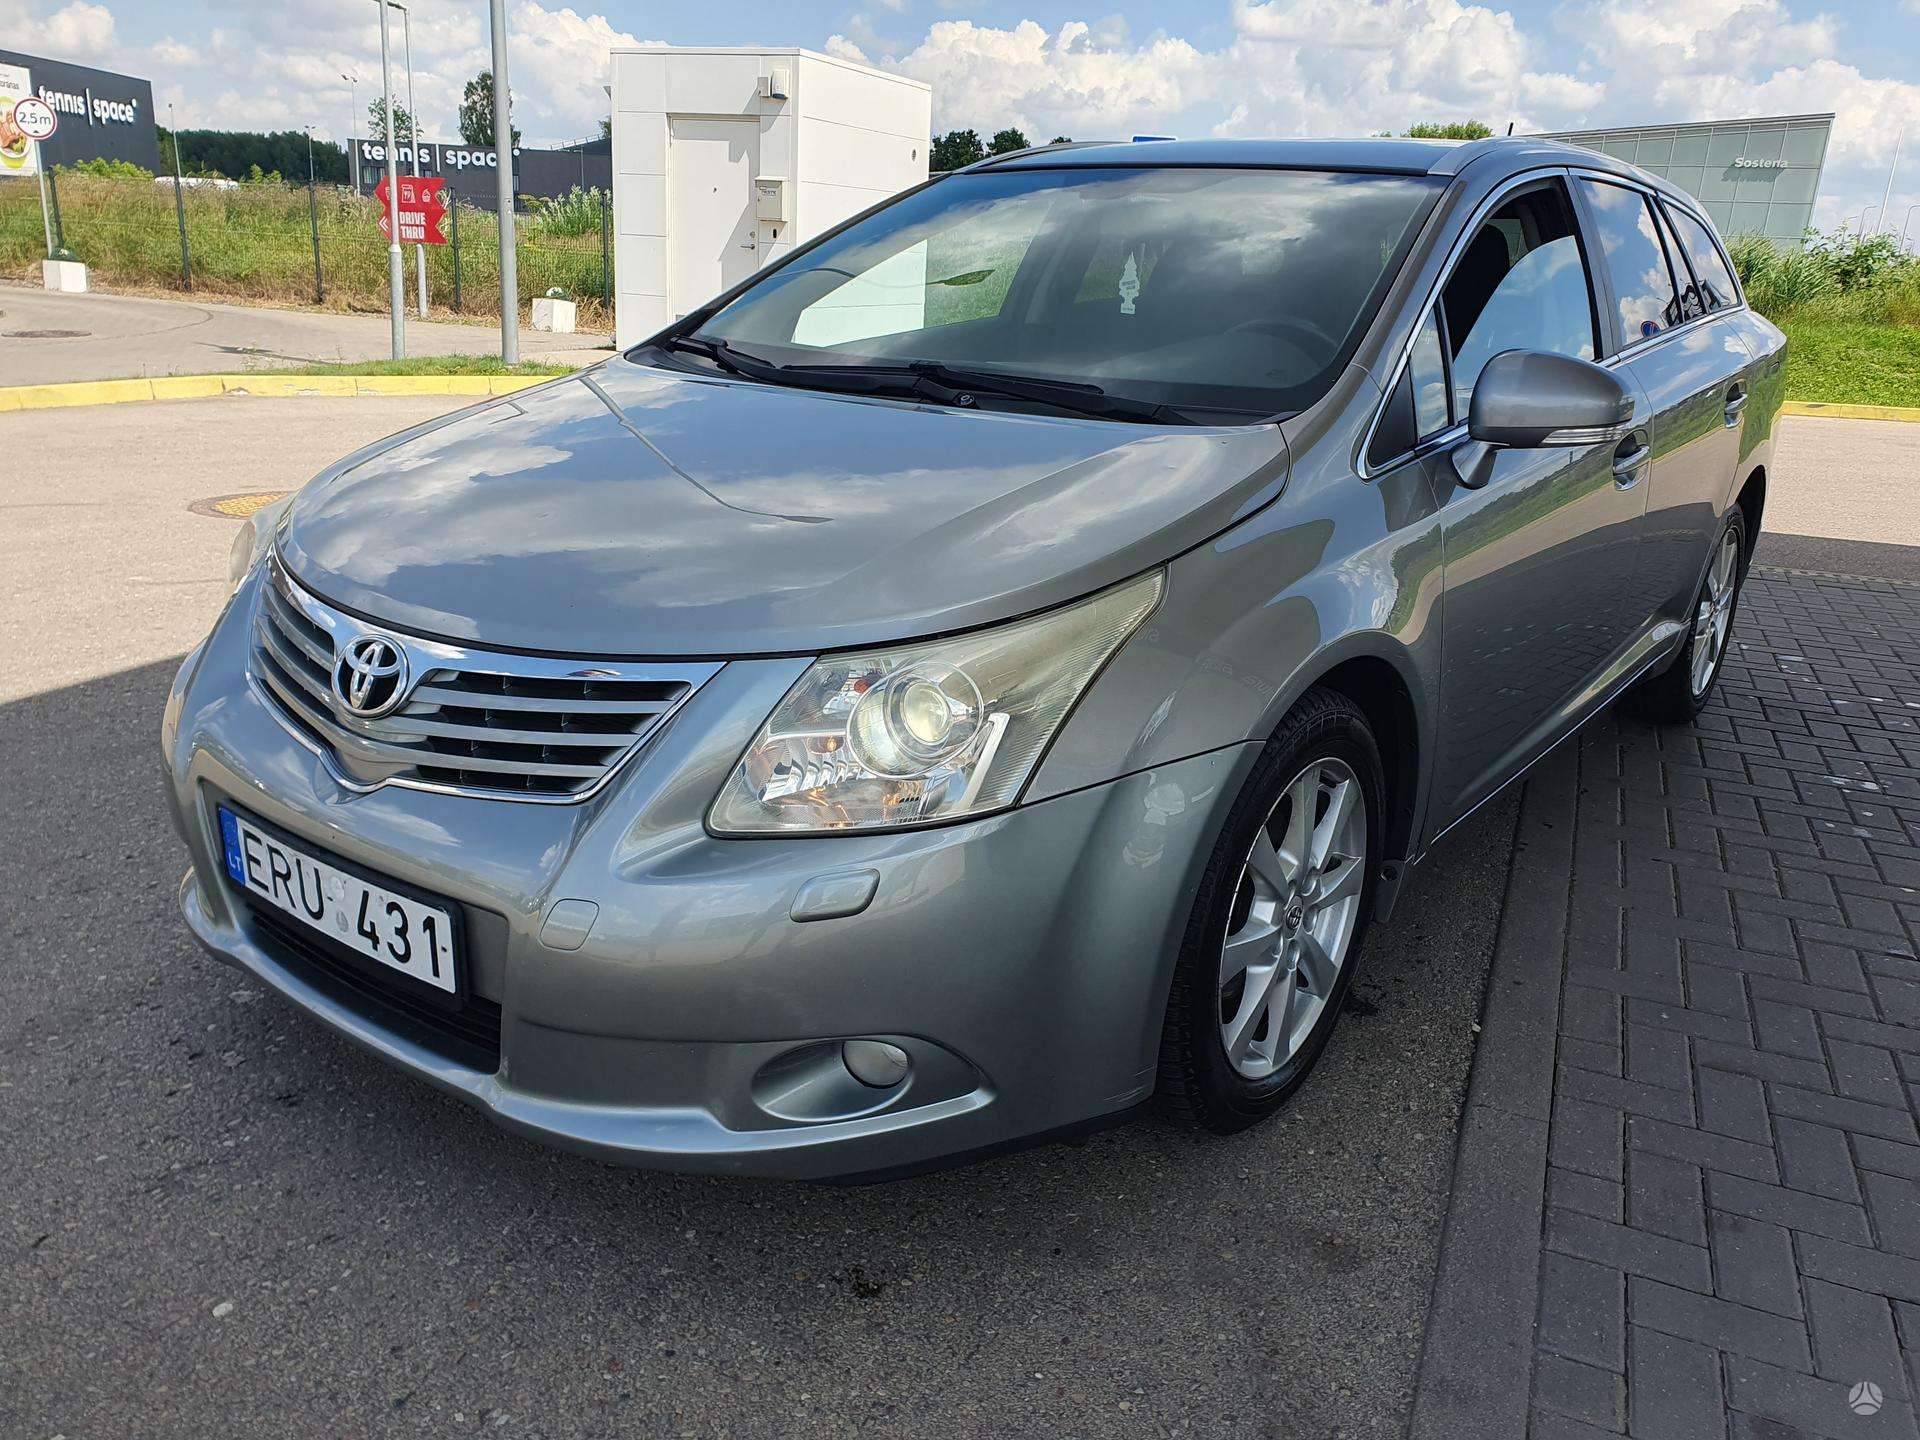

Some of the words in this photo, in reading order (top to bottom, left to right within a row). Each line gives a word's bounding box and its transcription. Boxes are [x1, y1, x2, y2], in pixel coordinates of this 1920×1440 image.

[38, 85, 86, 115] tennis
[93, 98, 134, 125] space
[19, 111, 38, 124] 2,5
[39, 116, 51, 125] m
[445, 149, 498, 170] spac
[1734, 157, 1788, 168] Sostena
[399, 211, 426, 225] DRIVE
[400, 225, 425, 239] THRU
[227, 851, 242, 872] LT
[242, 827, 325, 921] ERU
[357, 889, 441, 979] 431
